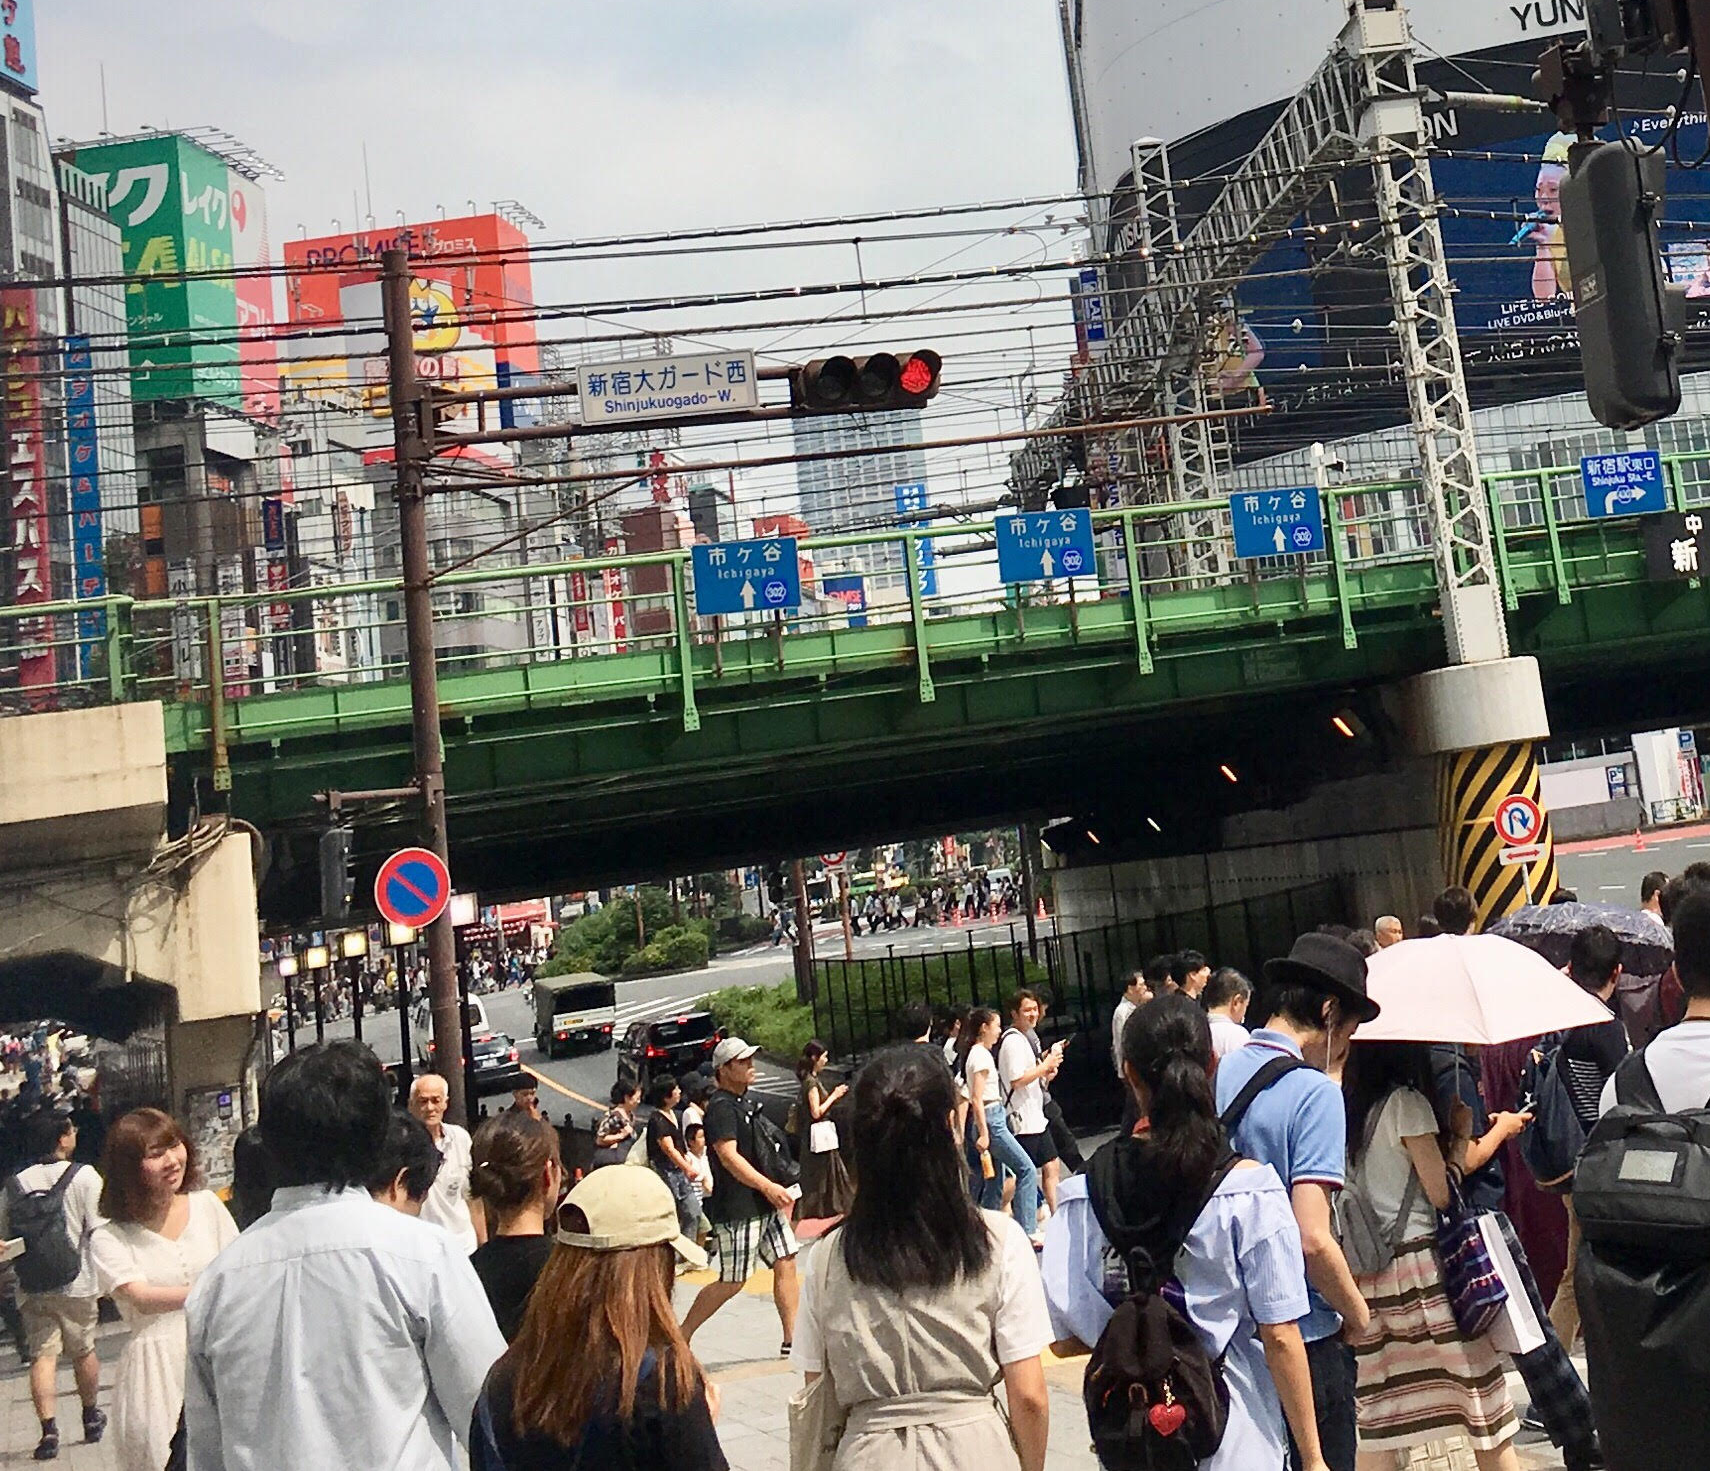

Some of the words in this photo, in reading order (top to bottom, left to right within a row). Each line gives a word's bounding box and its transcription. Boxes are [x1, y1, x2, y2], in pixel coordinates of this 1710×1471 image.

[181, 170, 228, 230] レイク
[1488, 317, 1511, 329] LIVE
[588, 360, 746, 397] 新宿大ガード西
[1587, 456, 1656, 476] 新宿駅東口
[1252, 513, 1301, 525] Ichigaya
[1019, 536, 1071, 548] Ichigaya
[717, 567, 775, 579] Ichigaya
